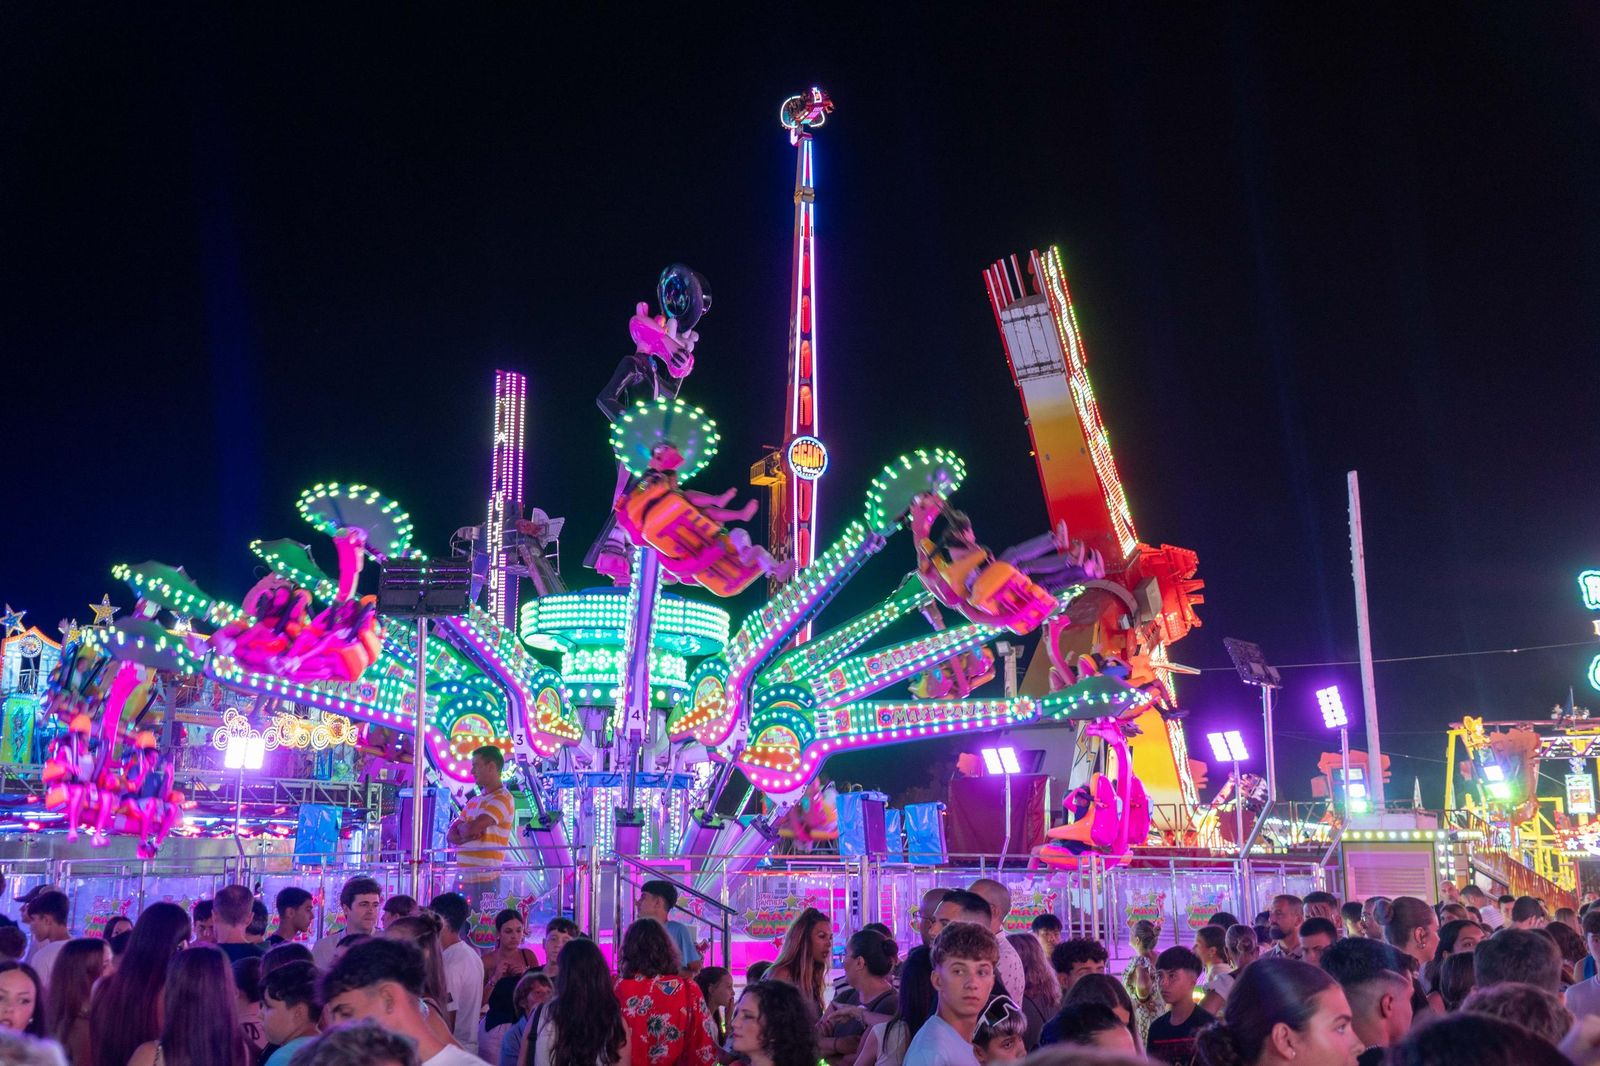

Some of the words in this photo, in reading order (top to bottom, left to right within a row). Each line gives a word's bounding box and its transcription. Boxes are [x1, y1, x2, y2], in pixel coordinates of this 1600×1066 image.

[792, 444, 824, 468] GIGANT
[631, 709, 640, 720] 4
[740, 720, 747, 732] 5
[516, 734, 524, 746] 3
